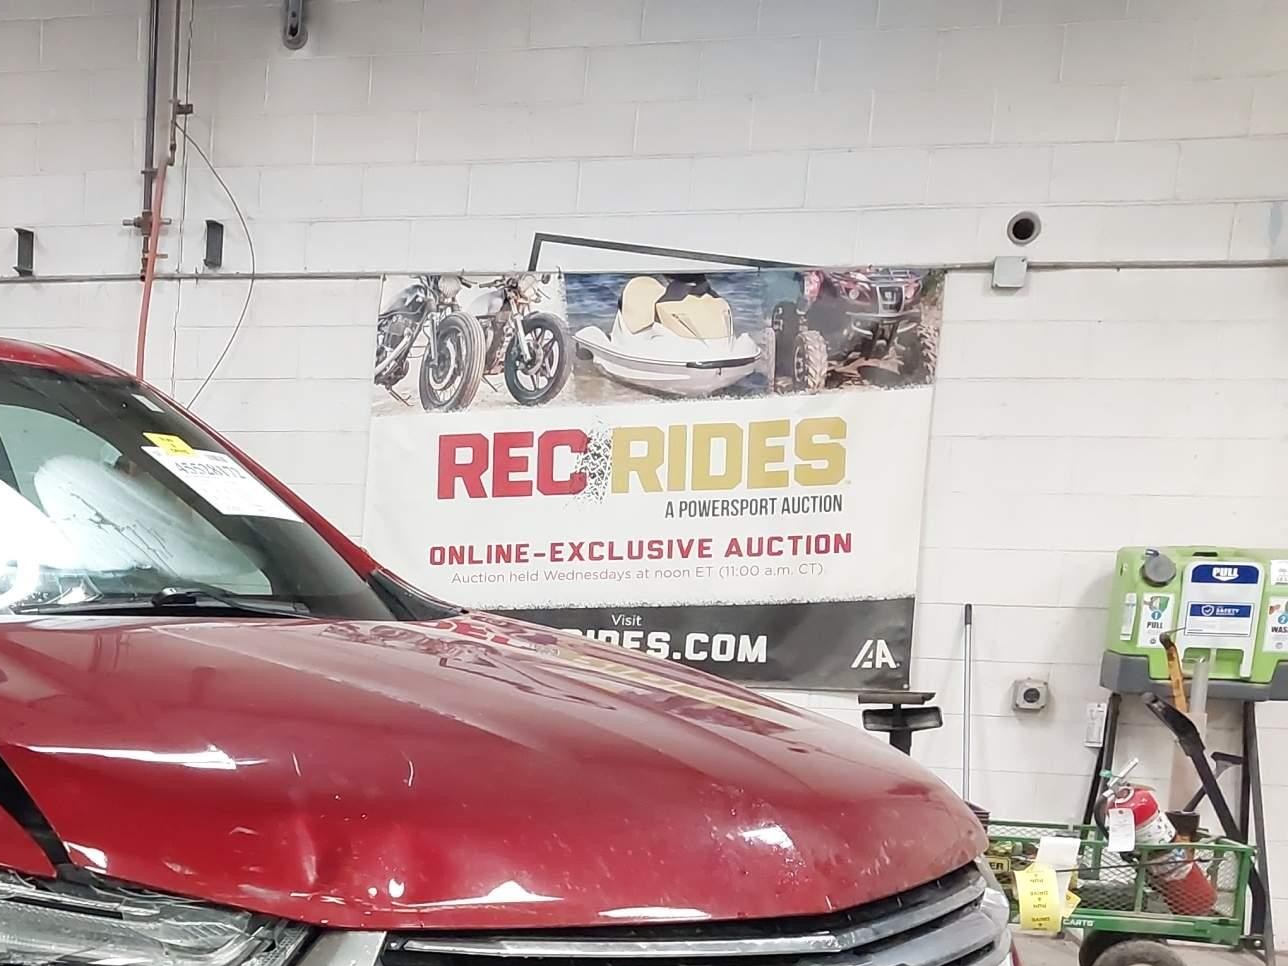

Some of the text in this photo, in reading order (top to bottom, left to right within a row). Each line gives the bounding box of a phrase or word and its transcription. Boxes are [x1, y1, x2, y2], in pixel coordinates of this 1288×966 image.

[437, 415, 847, 499] REC RIDES
[665, 494, 843, 518] A POWERSPORT AUCTION
[429, 533, 852, 565] ONLINE-EXCLUSIVE AUCTION
[451, 563, 824, 584] Auction held Wednesdays at noon ET (11:00 a.m. CT)
[1213, 567, 1239, 577] PULL
[611, 614, 643, 626] Visit
[1147, 621, 1163, 629] PULL
